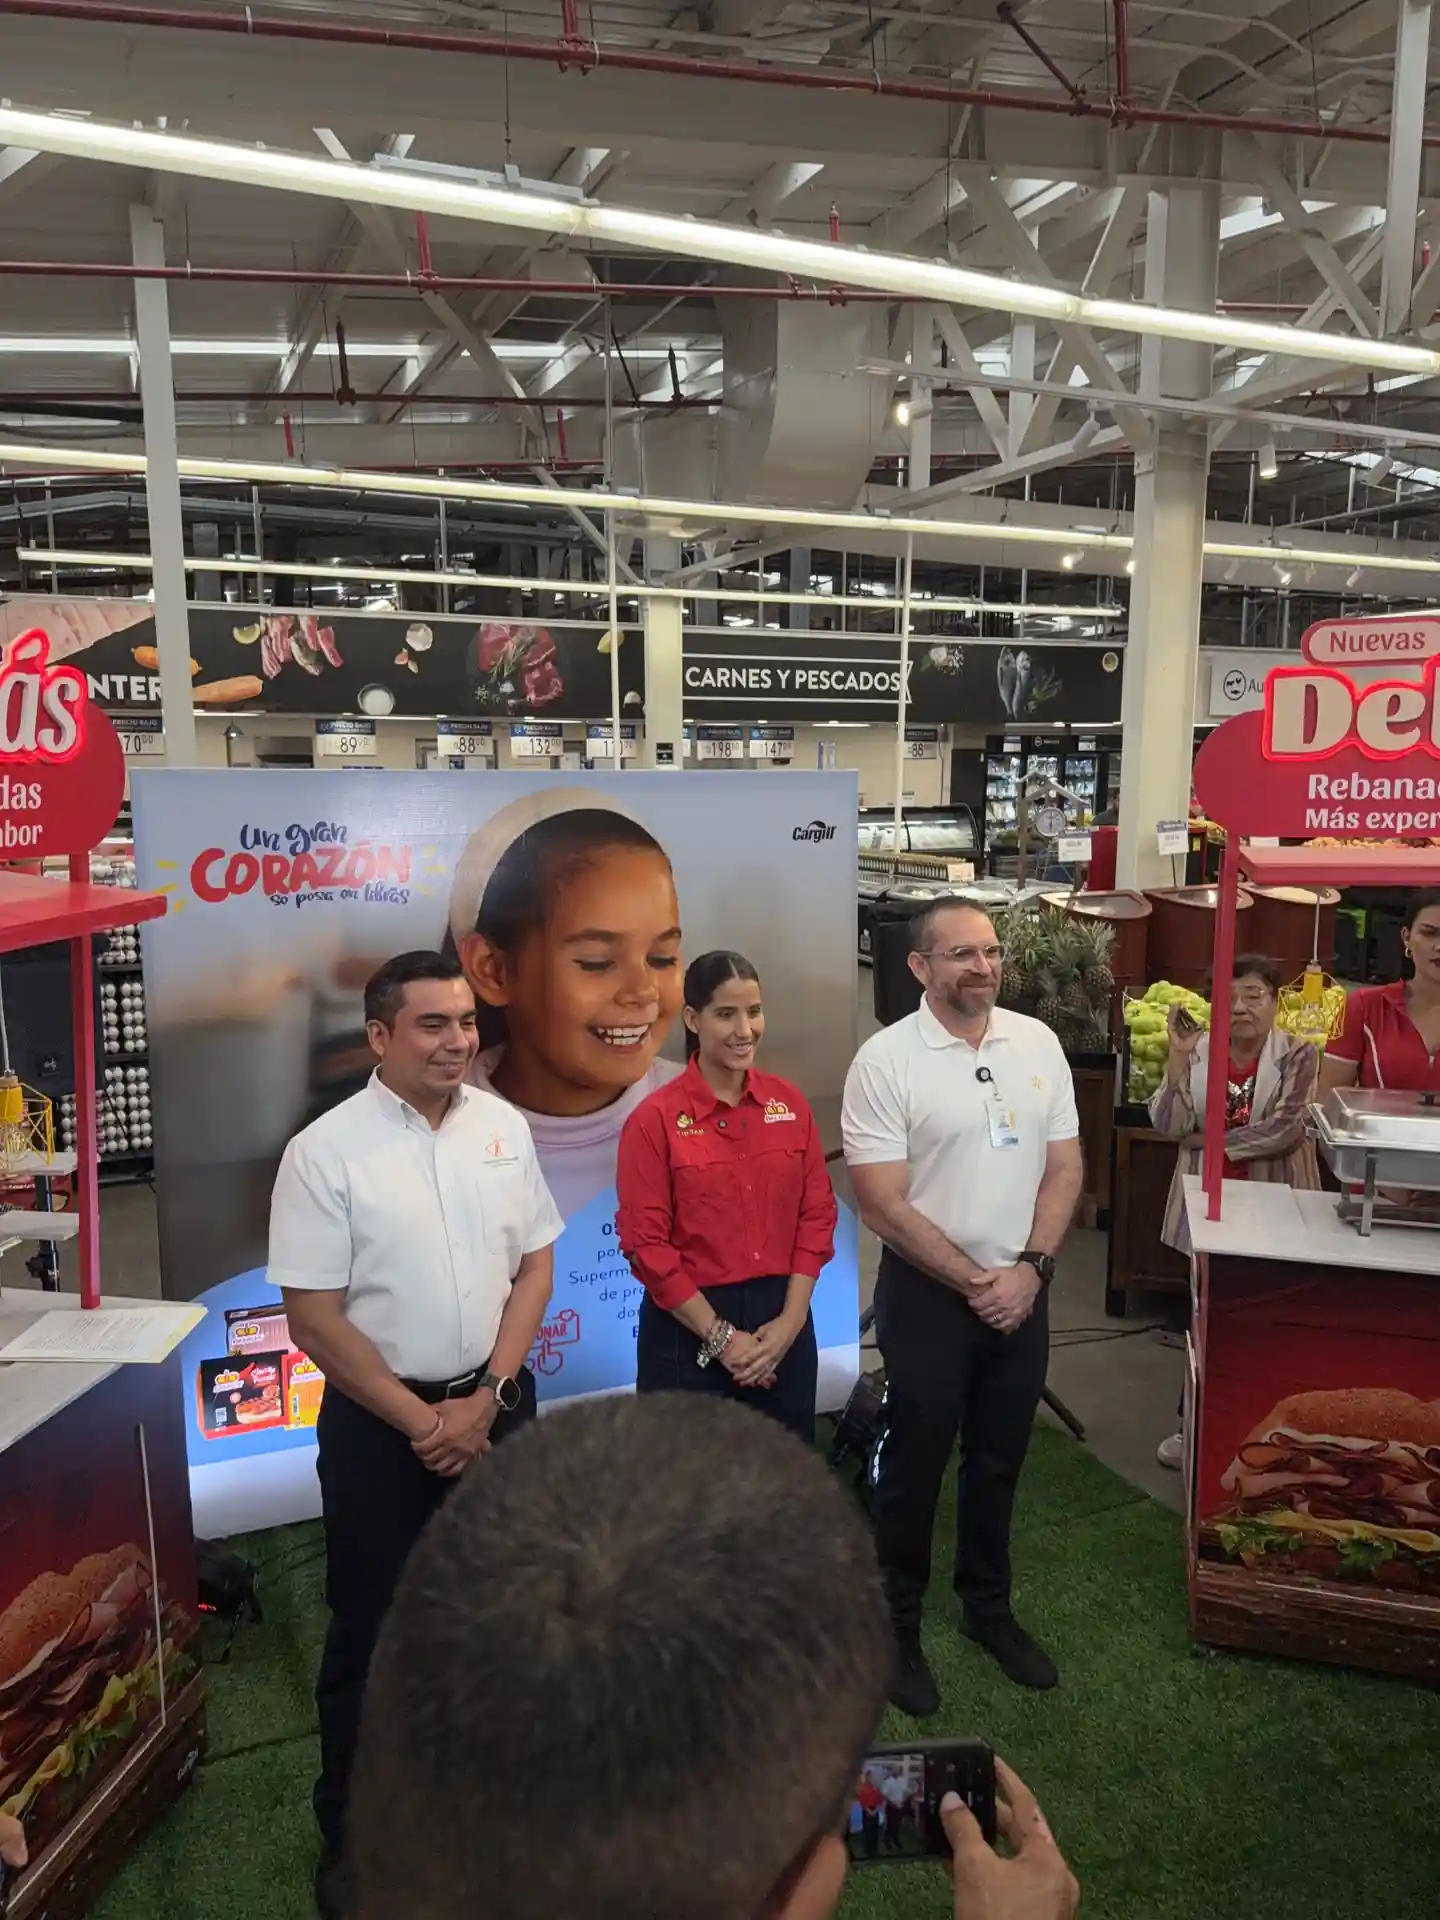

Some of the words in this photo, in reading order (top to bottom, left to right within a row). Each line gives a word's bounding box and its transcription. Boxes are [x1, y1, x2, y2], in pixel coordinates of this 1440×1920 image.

[1329, 630, 1426, 653] Nuevas
[684, 667, 772, 689] CARNES
[776, 669, 791, 689] Y
[795, 669, 901, 692] PESCADOS
[340, 736, 358, 753] 89
[459, 736, 476, 753] 88
[529, 738, 551, 754] 132
[711, 741, 732, 757] 198
[764, 741, 783, 757] 147
[1308, 772, 1440, 801] Rebana
[1305, 805, 1360, 829] Más
[0, 819, 43, 847] bor
[240, 824, 280, 851] Un
[285, 821, 348, 857] gran
[792, 821, 838, 843] Cargill
[190, 839, 413, 903] CORAZÓN
[364, 881, 410, 904] libras
[599, 1286, 618, 1302] de
